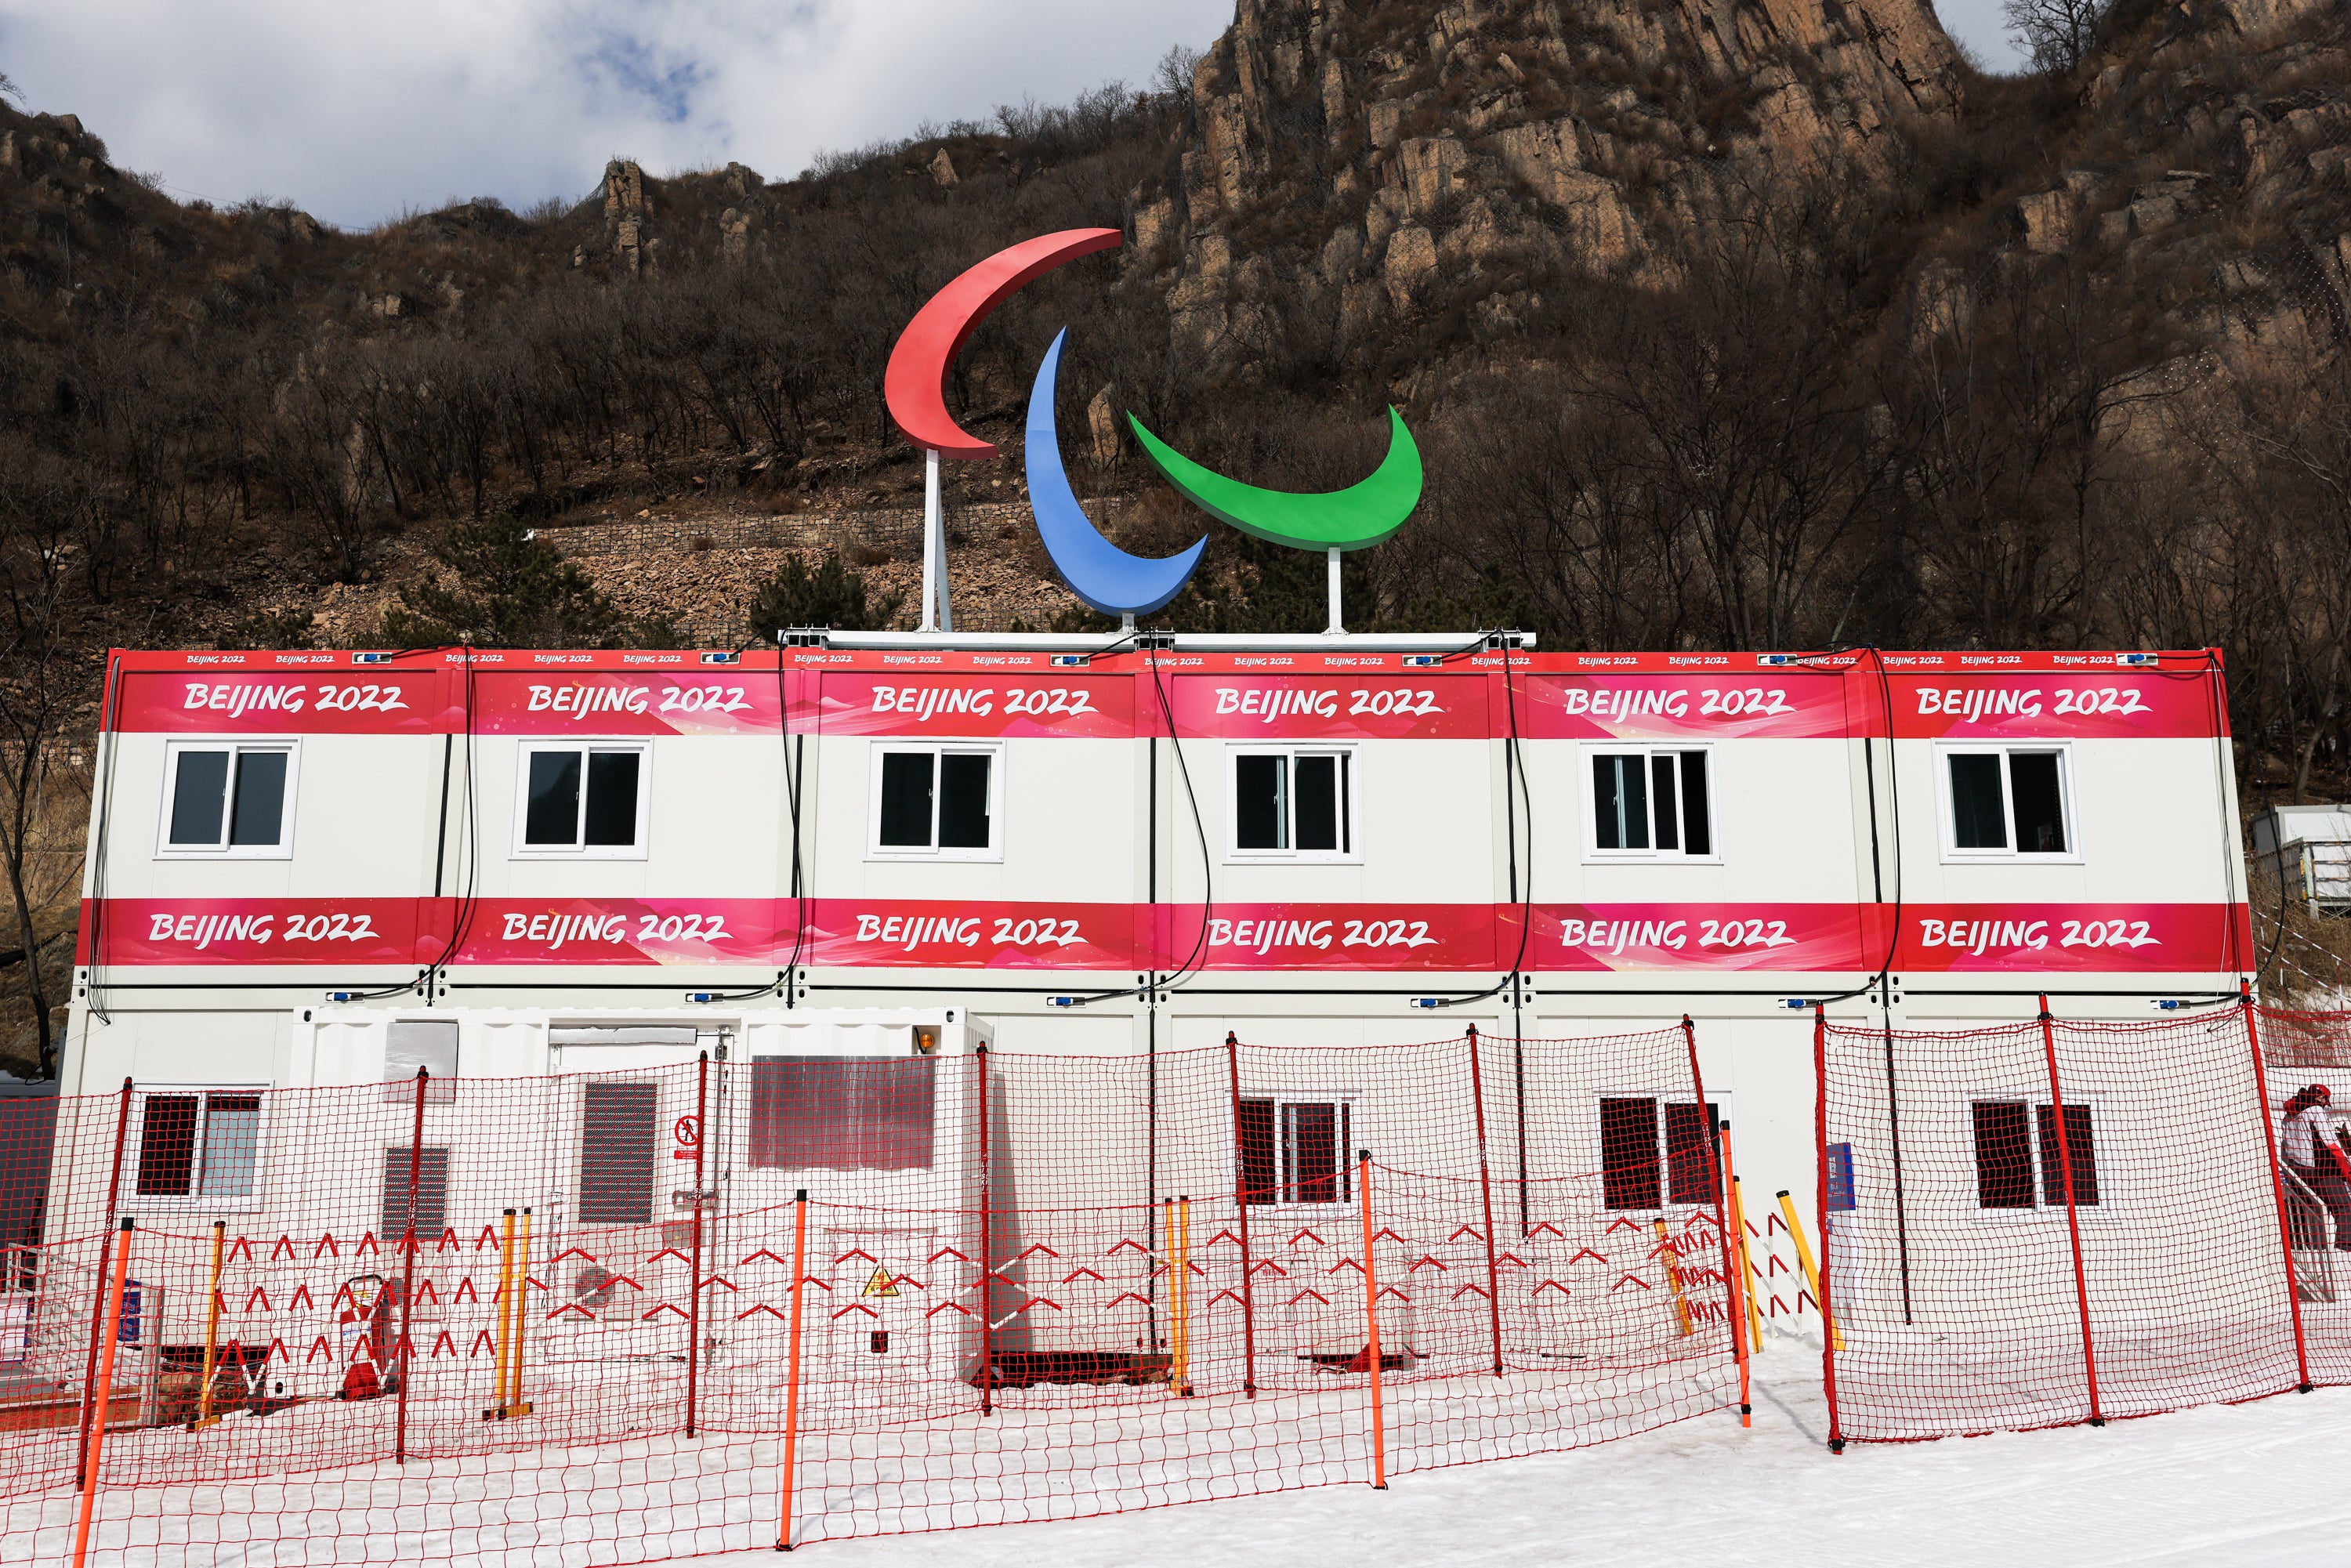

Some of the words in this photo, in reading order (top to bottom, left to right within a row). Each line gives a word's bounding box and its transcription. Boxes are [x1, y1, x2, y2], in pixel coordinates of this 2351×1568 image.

[187, 655, 219, 665] BEIJING
[221, 655, 246, 664] 2022
[275, 655, 309, 665] BEIJING
[480, 654, 505, 663] 2022
[534, 654, 567, 665] BEIJING
[568, 654, 594, 663] 2022
[623, 654, 656, 665] BEIJING
[657, 654, 683, 663] 2022
[794, 654, 828, 664] BEIJING
[828, 654, 854, 663] 2022
[883, 655, 917, 666] BEIJING
[918, 655, 944, 664] 2022
[973, 656, 1006, 667] BEIJING
[1007, 657, 1034, 665] 2022
[1179, 657, 1205, 666] 2022
[1233, 657, 1267, 668] BEIJING
[1269, 657, 1295, 665] 2022
[1324, 657, 1357, 668] BEIJING
[1471, 657, 1505, 668] BEIJING
[1508, 657, 1532, 665] 2022
[1578, 657, 1611, 668] BEIJING
[1613, 657, 1639, 665] 2022
[1668, 656, 1702, 667] BEIJING
[1704, 656, 1730, 664] 2022
[1832, 657, 1857, 665] 2022
[1882, 656, 1917, 667] BEIJING
[1918, 656, 1945, 664] 2022
[1961, 656, 1994, 666] BEIJING
[1997, 655, 2023, 664] 2022
[2052, 655, 2087, 666] BEIJING
[2088, 656, 2115, 664] 2022
[183, 683, 306, 719] BEIJING
[314, 685, 411, 712] 2022
[527, 685, 650, 720] BEIJING
[658, 686, 755, 713] 2022
[871, 686, 994, 722] BEIJING
[1003, 688, 1100, 716] 2022
[1215, 688, 1339, 723] BEIJING
[1348, 689, 1446, 716] 2022
[1563, 688, 1689, 724] BEIJING
[1699, 688, 1798, 715] 2022
[1915, 688, 2042, 723] BEIJING
[2053, 687, 2154, 715] 2022
[149, 914, 274, 950] BEIJING
[283, 913, 382, 942] 2022
[502, 913, 627, 950] BEIJING
[636, 914, 735, 943] 2022
[856, 914, 981, 952] BEIJING
[991, 918, 1090, 947] 2022
[1208, 918, 1333, 955] BEIJING
[1341, 919, 1440, 948] 2022
[1559, 919, 1687, 956] BEIJING
[1697, 919, 1799, 948] 2022
[1919, 919, 2049, 956] BEIJING
[2059, 919, 2163, 948] 2022
